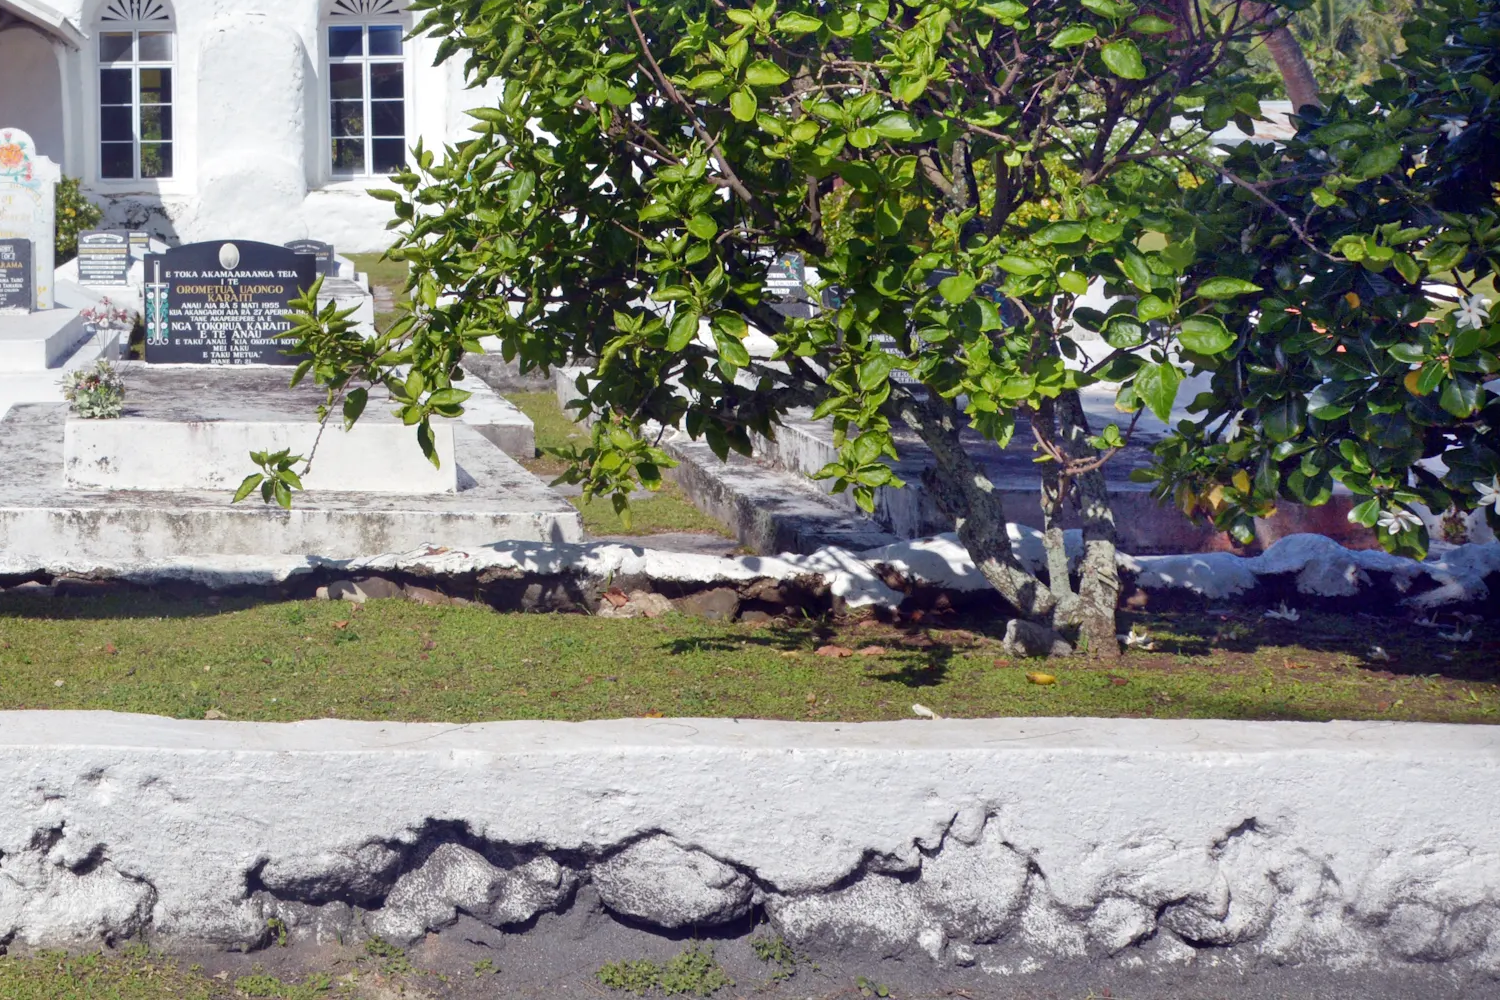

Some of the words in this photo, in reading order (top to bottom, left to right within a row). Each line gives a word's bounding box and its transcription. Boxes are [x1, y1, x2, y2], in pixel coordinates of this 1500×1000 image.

[176, 285, 234, 294] OROMETUA
[207, 294, 253, 302] KARAITI
[171, 322, 192, 330] NGA
[195, 322, 242, 330] TOKORUA
[247, 322, 291, 330] KARAITI
[200, 330, 207, 339] E
[212, 330, 226, 339] TE
[232, 330, 262, 339] ANAU
